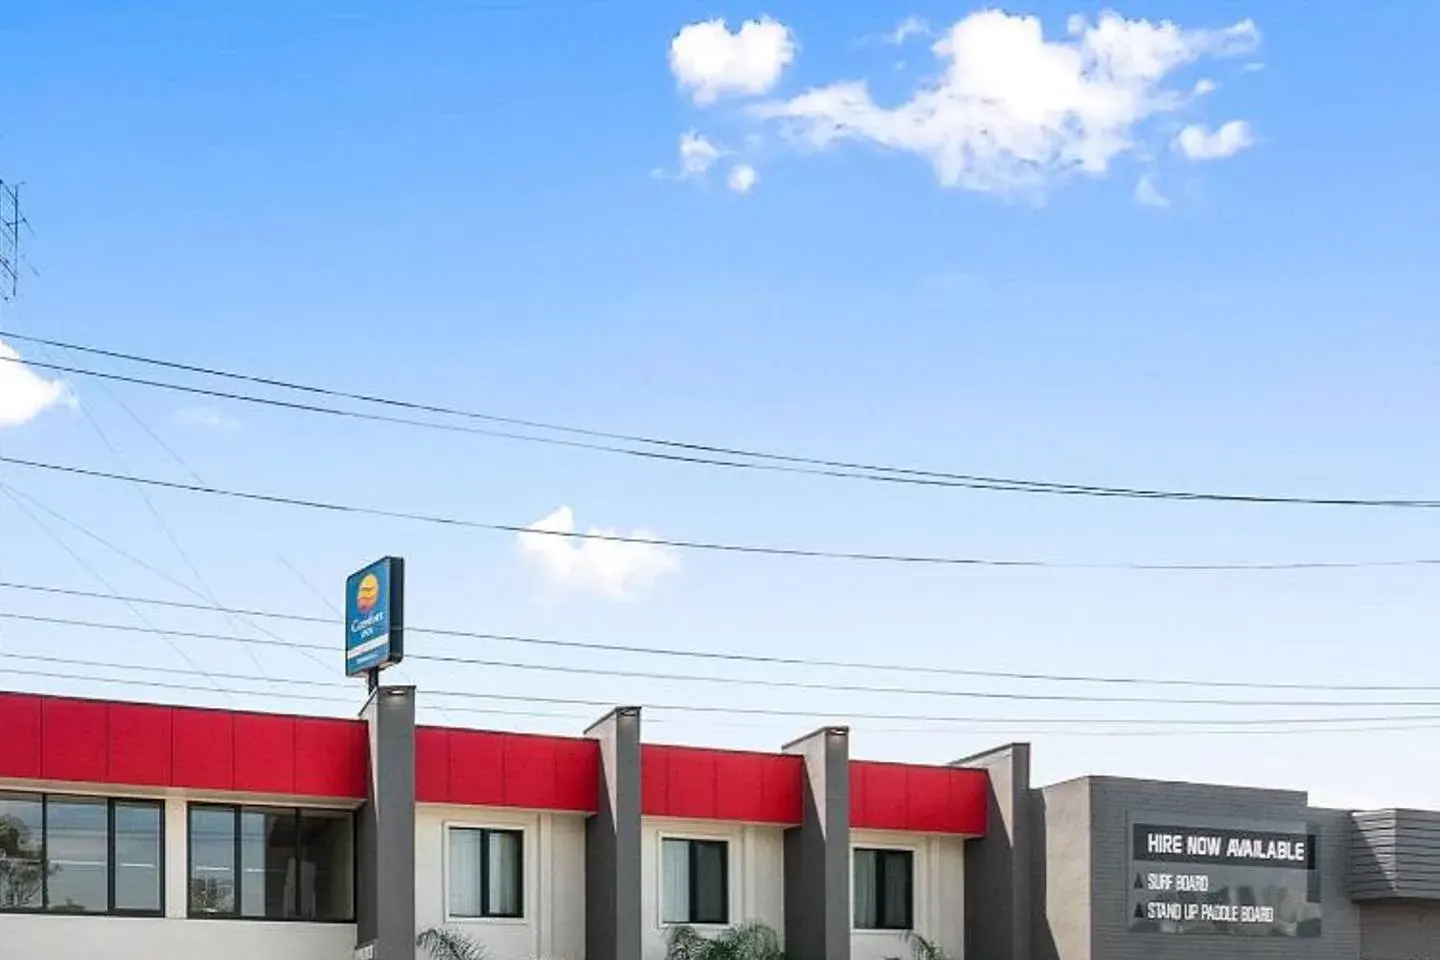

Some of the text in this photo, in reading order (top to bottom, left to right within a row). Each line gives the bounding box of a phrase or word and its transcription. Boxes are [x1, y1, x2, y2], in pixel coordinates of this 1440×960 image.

[1147, 833, 1305, 861] HIRE NOW AVAILABLE
[1147, 873, 1209, 892] SURF BOARD
[1147, 902, 1274, 923] STAND UP PADDLE BOARD
